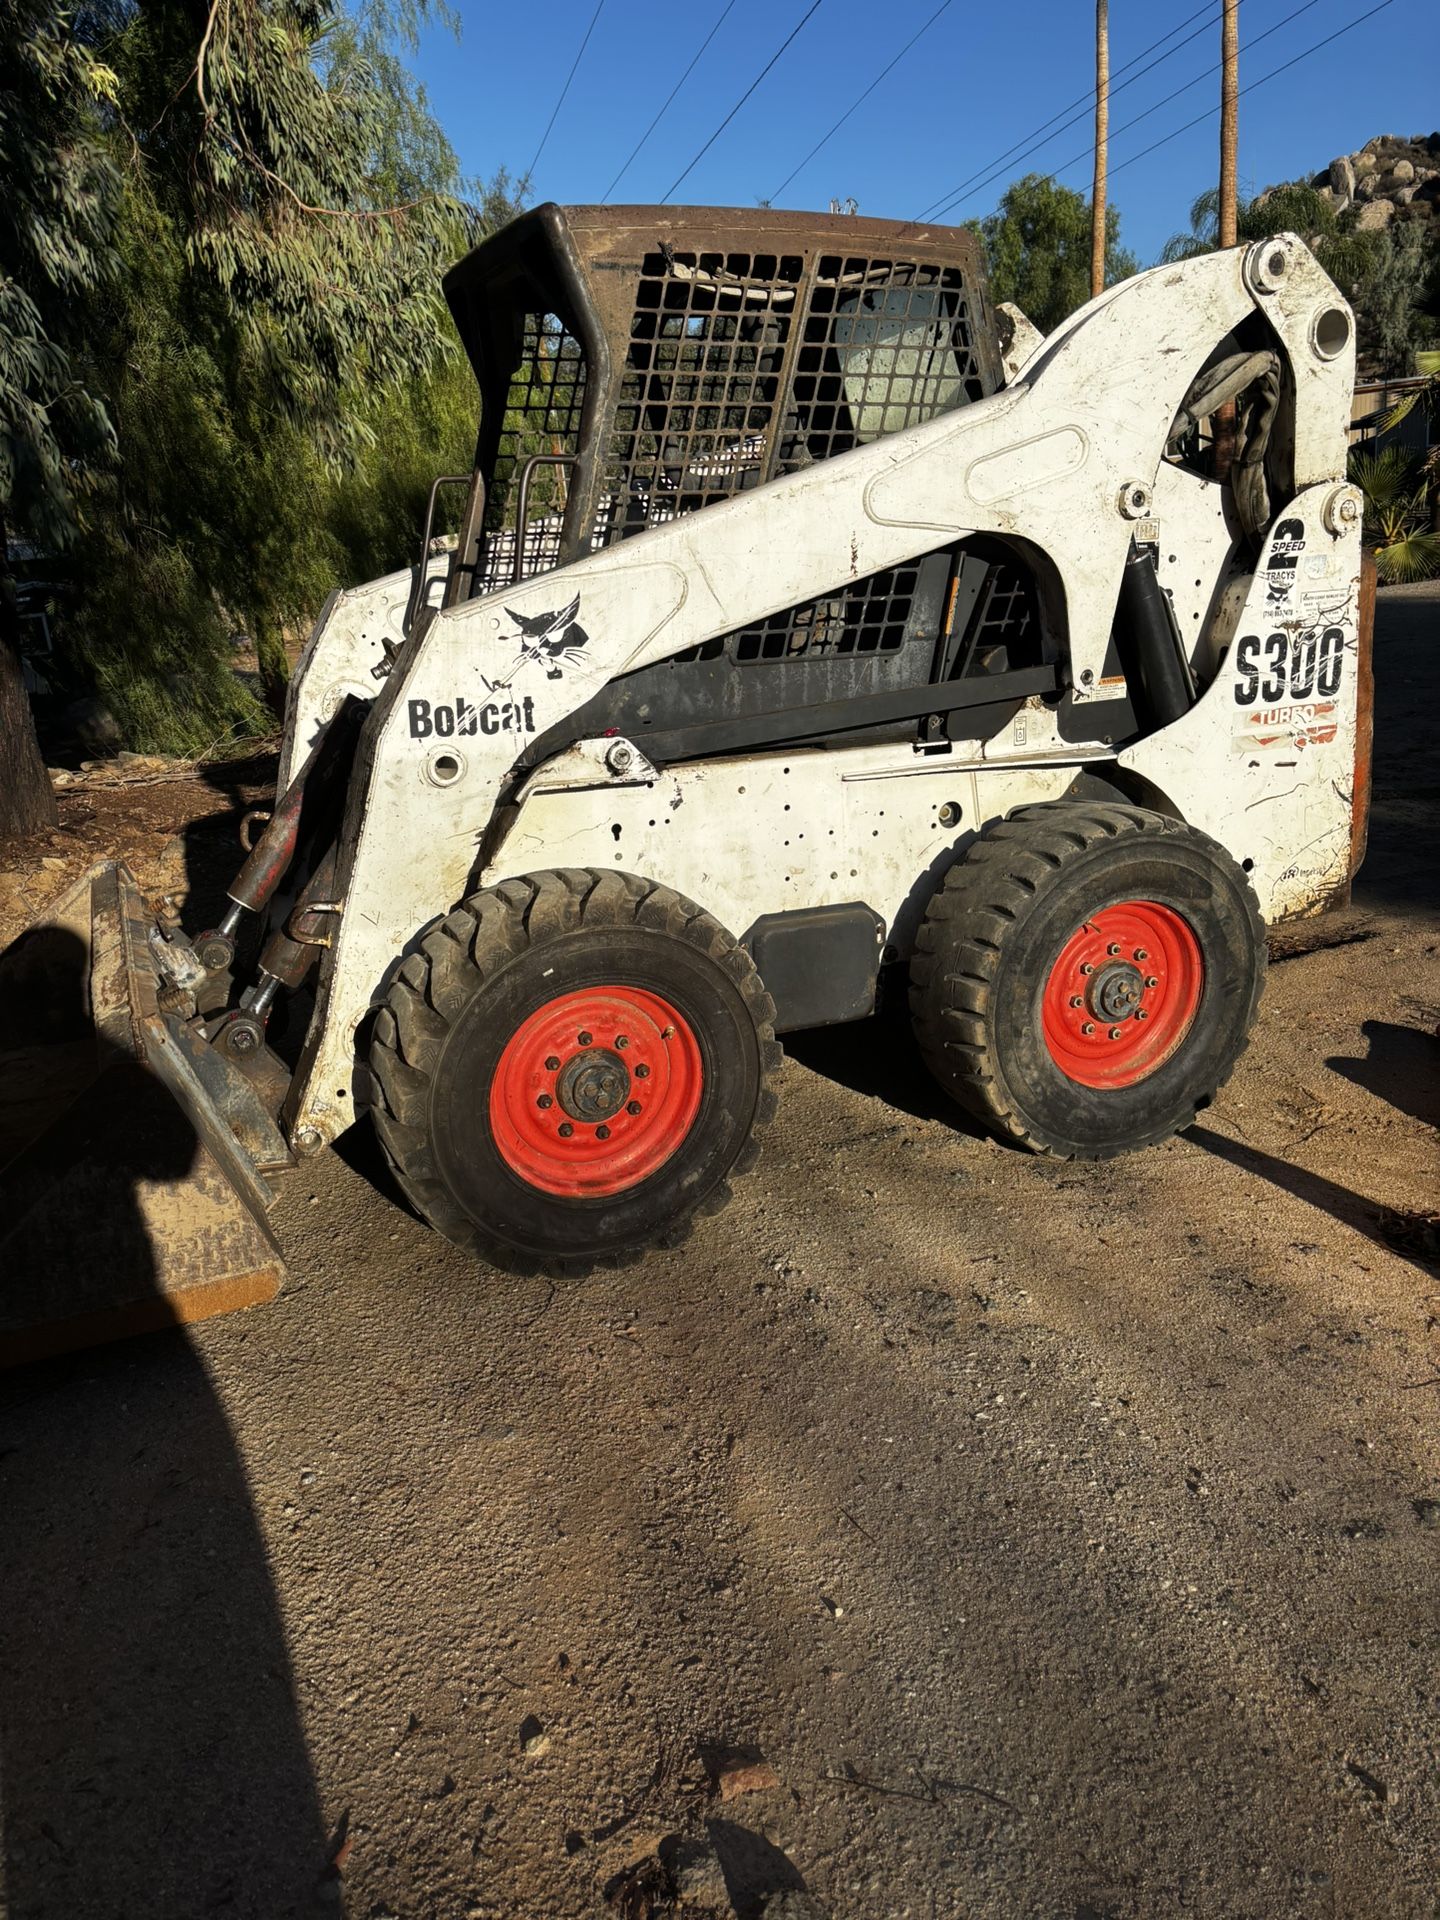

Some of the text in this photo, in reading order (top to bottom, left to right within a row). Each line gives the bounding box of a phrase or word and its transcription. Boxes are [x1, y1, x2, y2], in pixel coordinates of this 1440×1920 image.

[1267, 518, 1304, 570] 2
[1271, 541, 1306, 552] SPEED
[1266, 571, 1295, 580] TRACYS
[1234, 628, 1344, 705] S300
[408, 696, 536, 738] Bobcat
